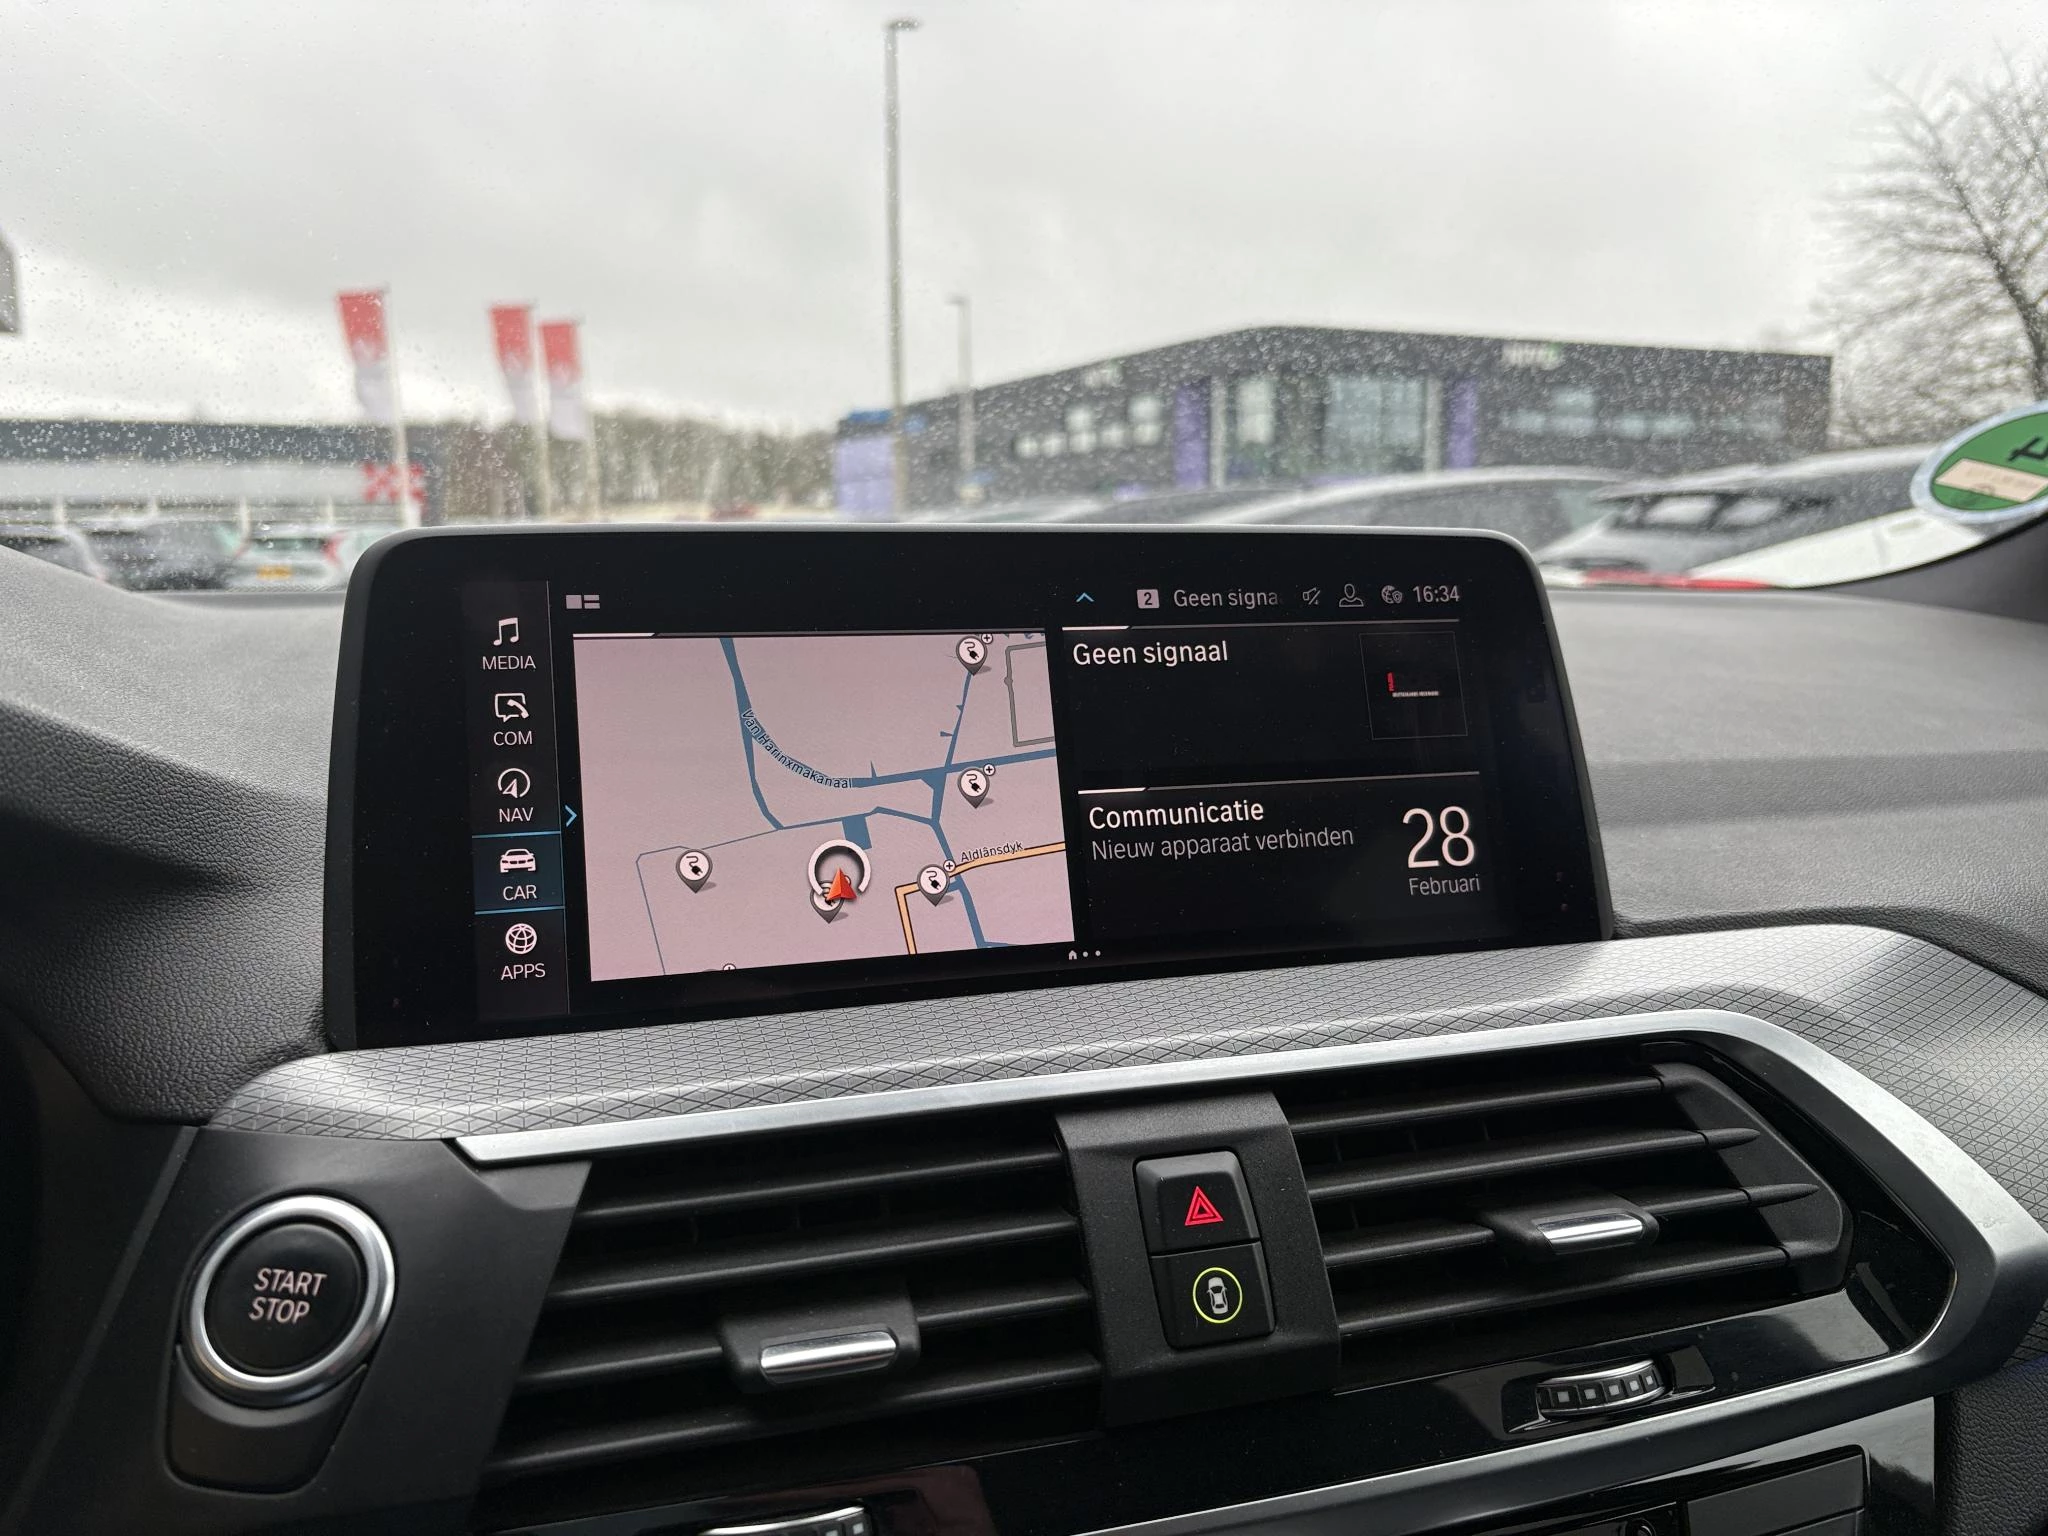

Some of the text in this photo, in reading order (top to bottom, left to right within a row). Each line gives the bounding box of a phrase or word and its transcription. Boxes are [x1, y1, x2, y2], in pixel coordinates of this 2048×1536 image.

[1143, 592, 1153, 606] 2
[1173, 588, 1279, 610] Geen signa
[1412, 585, 1460, 603] 16:34
[482, 655, 536, 671] MEDIA
[1072, 640, 1228, 667] Geen signaal
[493, 731, 533, 746] COM
[742, 709, 852, 789] Van Harinxmakanaal
[499, 807, 534, 823] NAV
[1089, 801, 1264, 829] Communicatie
[1092, 826, 1354, 860] Nieuw apparaat verbinden
[1402, 806, 1475, 869] 28
[961, 841, 1023, 862] Aldlânsdyk
[502, 885, 537, 901] CAR
[1408, 874, 1481, 895] Februari
[501, 963, 546, 980] APPS
[253, 1267, 328, 1296] START
[249, 1297, 310, 1324] STOP
